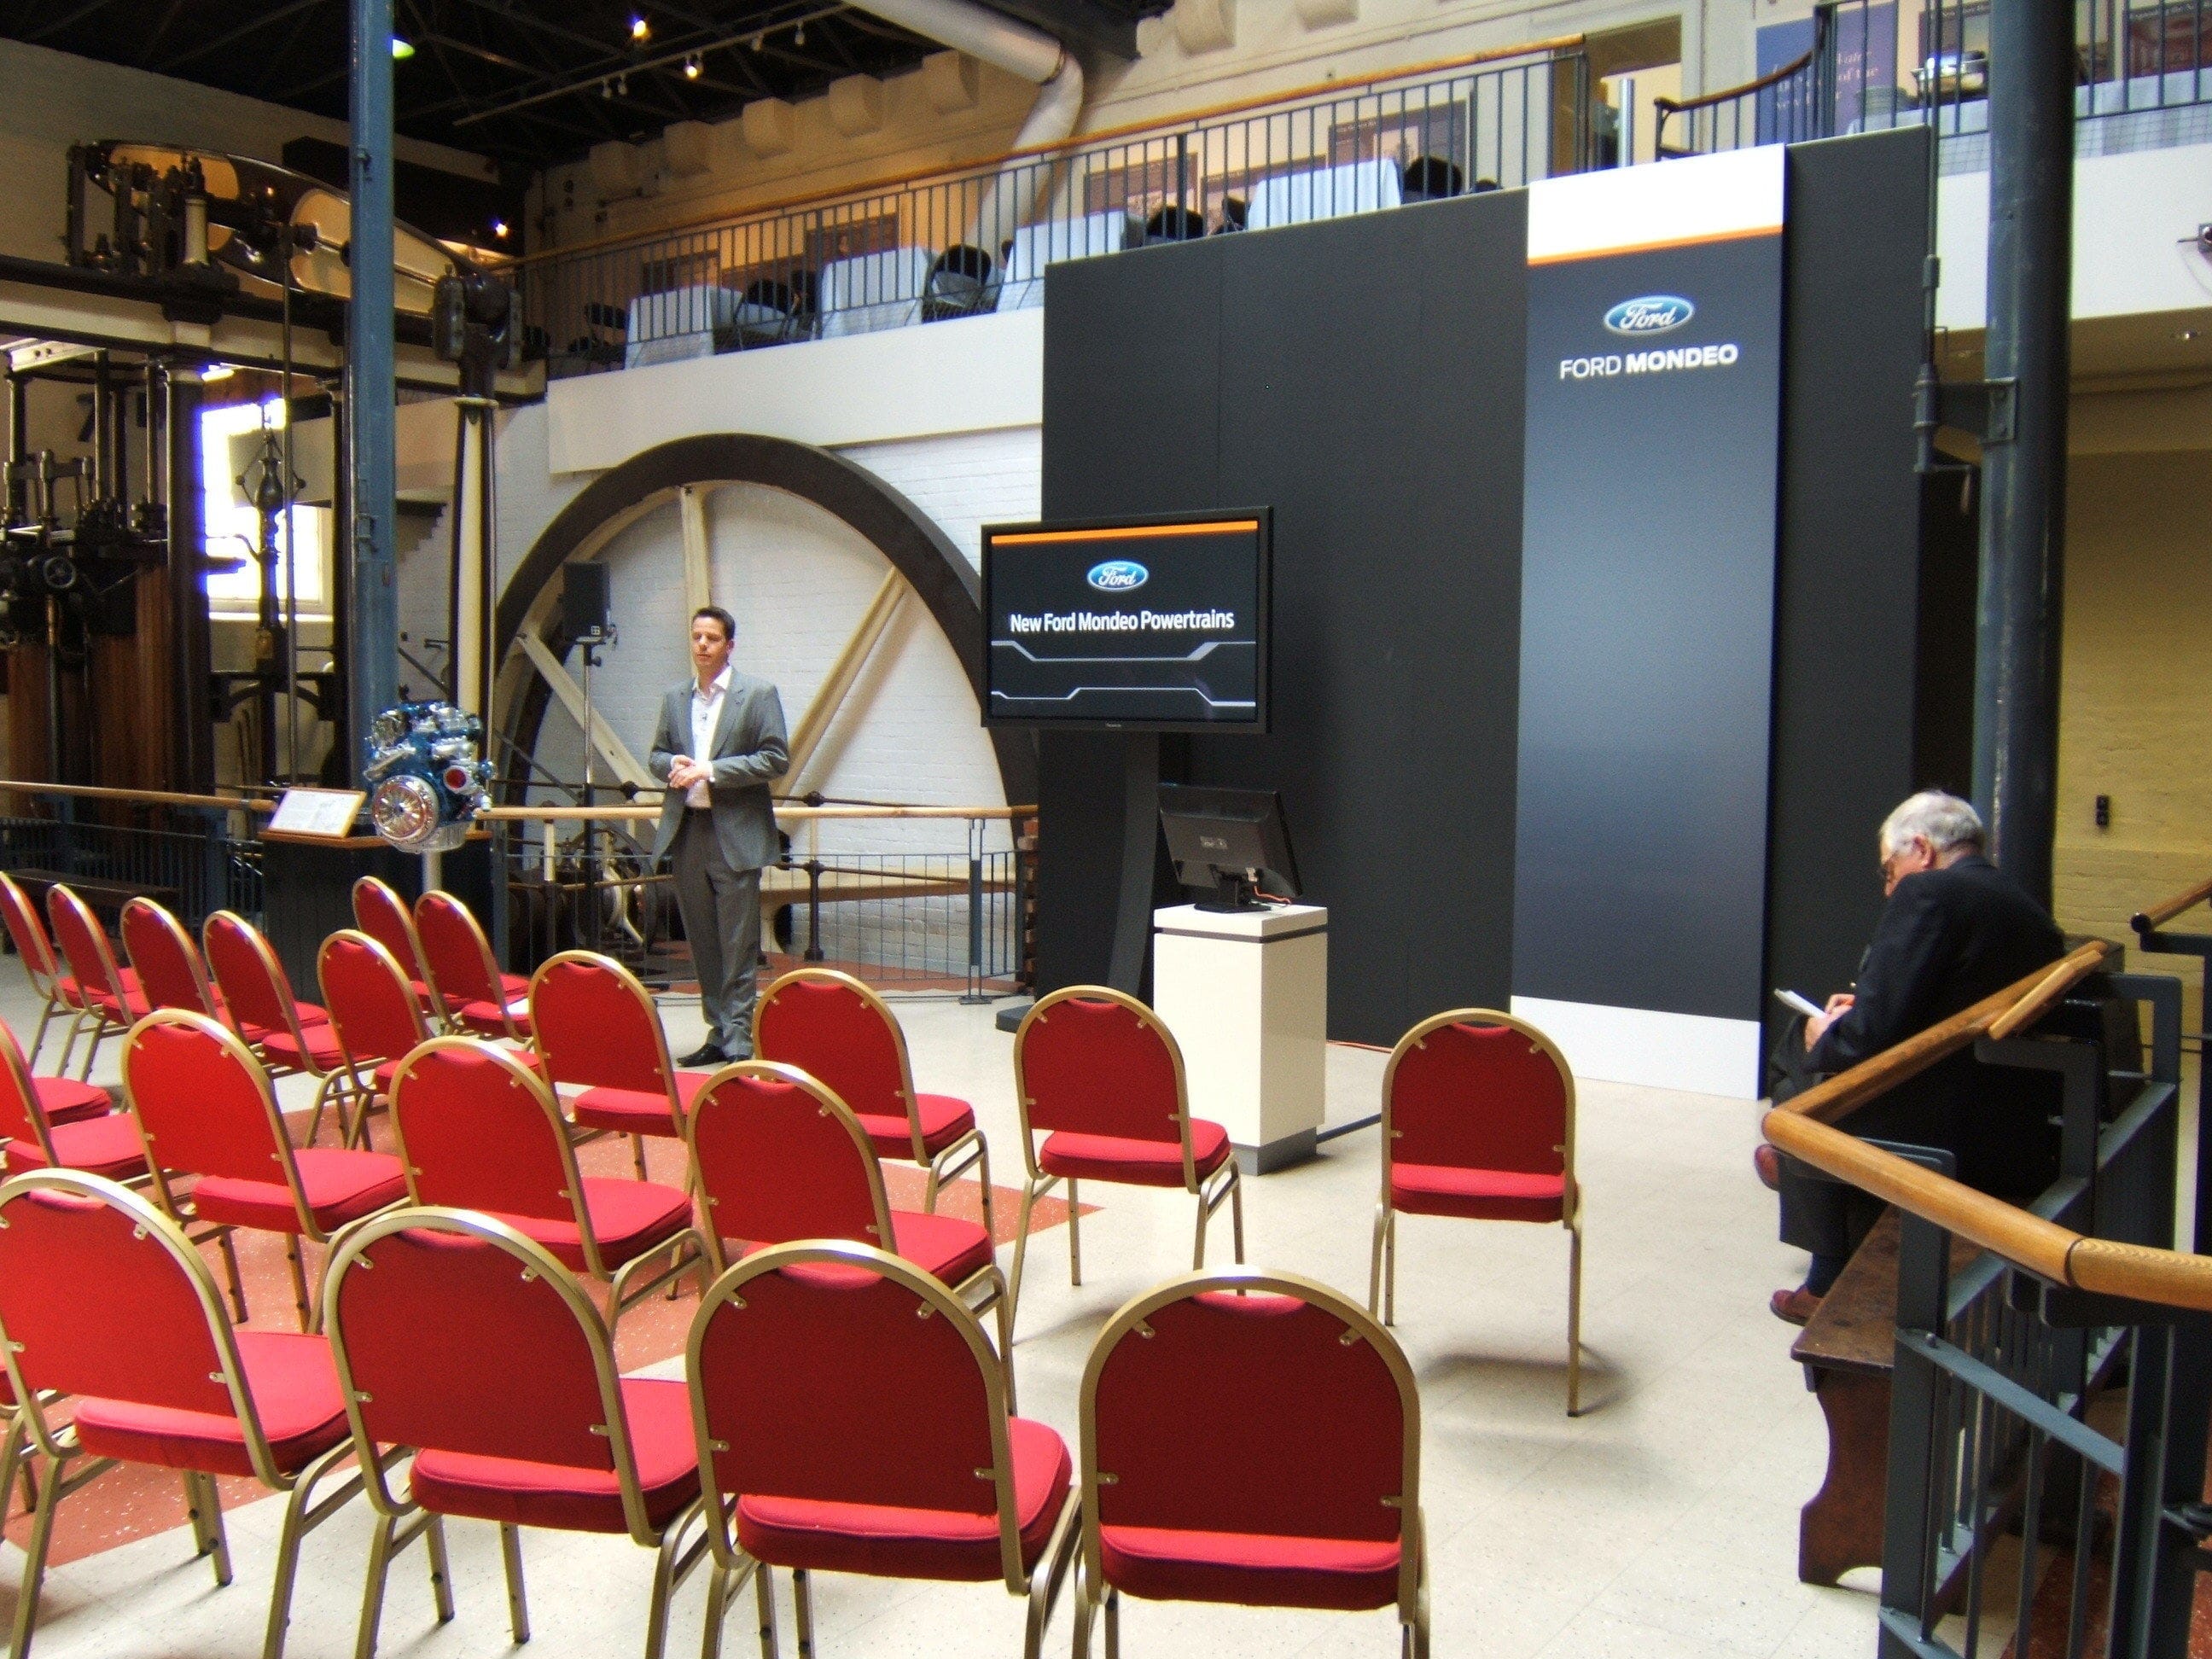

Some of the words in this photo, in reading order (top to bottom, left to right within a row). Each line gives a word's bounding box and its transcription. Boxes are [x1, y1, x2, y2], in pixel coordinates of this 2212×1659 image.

[1619, 303, 1678, 330] Ford
[1559, 355, 1621, 380] FORD
[1625, 343, 1738, 374] MONDEO
[1098, 567, 1137, 586] Ford
[1010, 614, 1042, 632] New
[1044, 612, 1076, 632] Ford
[1078, 610, 1138, 631] Mondeo
[1141, 608, 1235, 630] Powertrains
